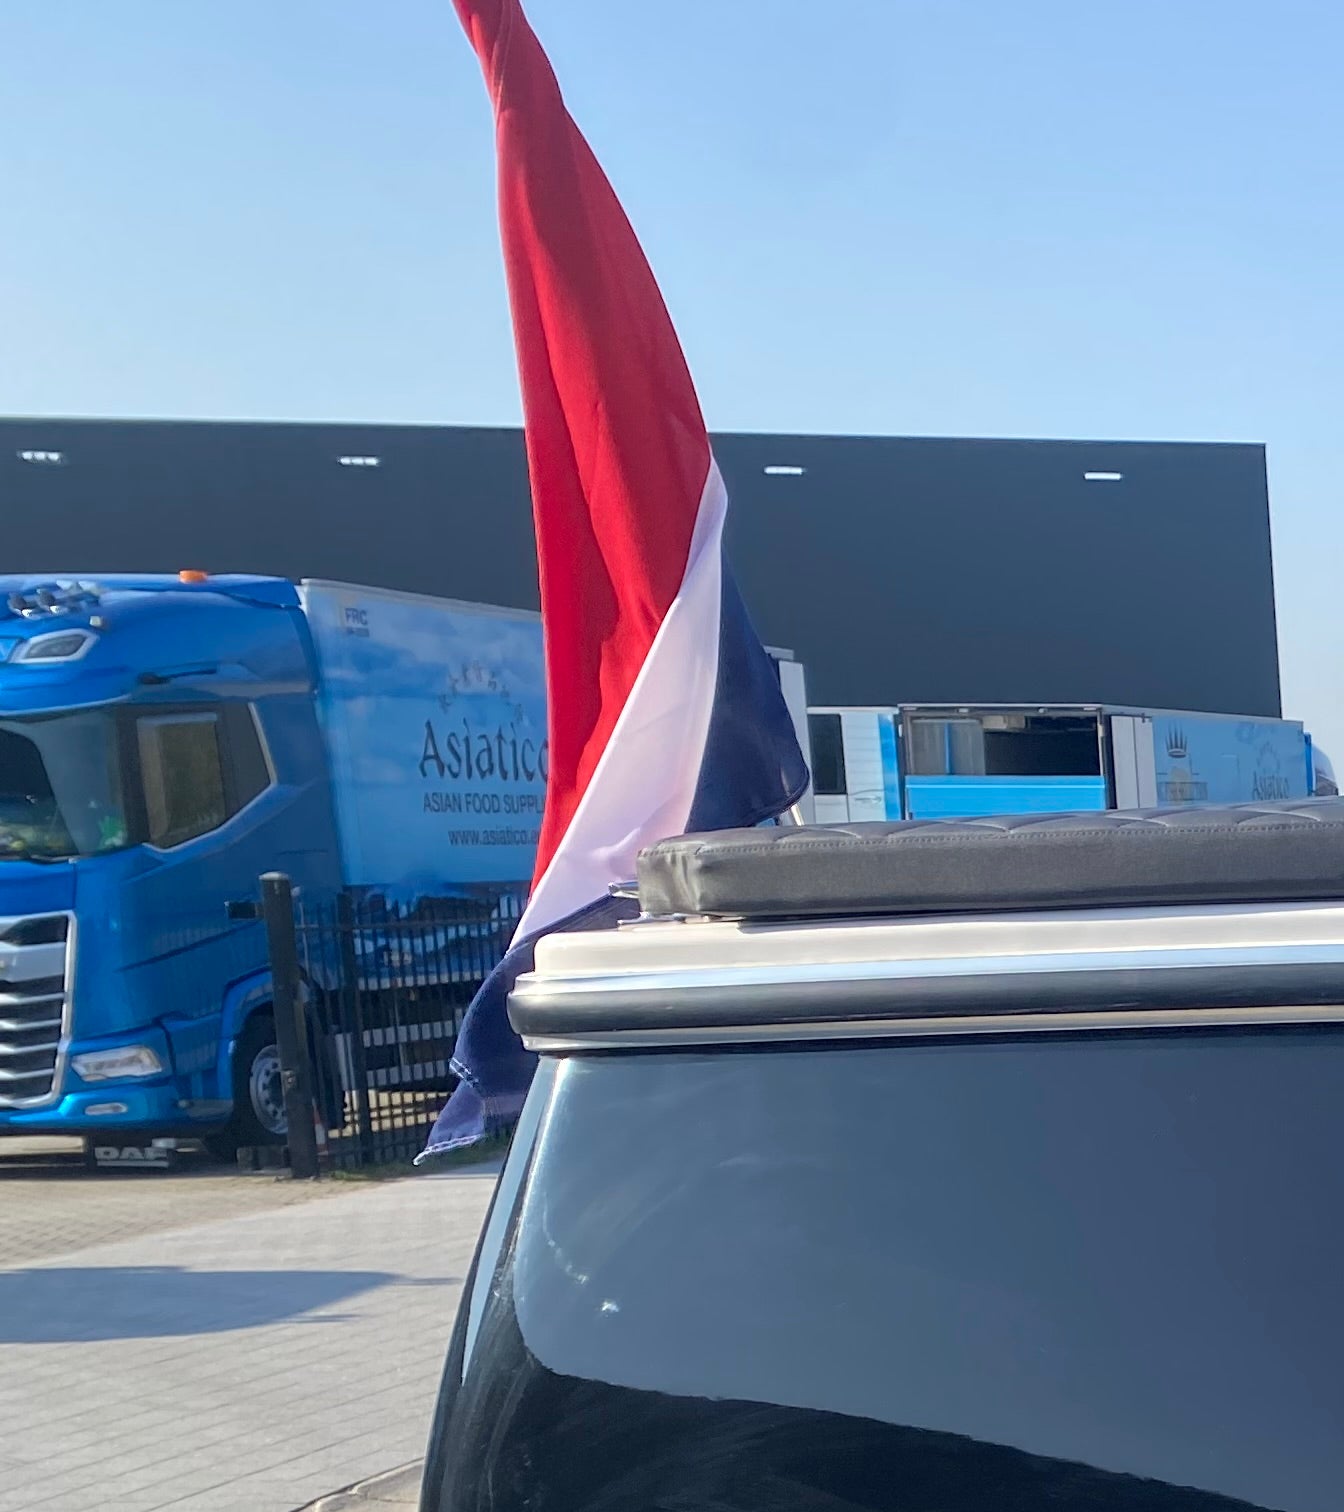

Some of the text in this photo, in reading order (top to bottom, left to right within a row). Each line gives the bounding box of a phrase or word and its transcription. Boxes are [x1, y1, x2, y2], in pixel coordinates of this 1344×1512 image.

[345, 607, 368, 625] FRC
[423, 792, 462, 813] ASIAN
[465, 793, 501, 813] FOOD
[448, 826, 540, 846] www.asiatico.e
[94, 1147, 167, 1160] DAF
